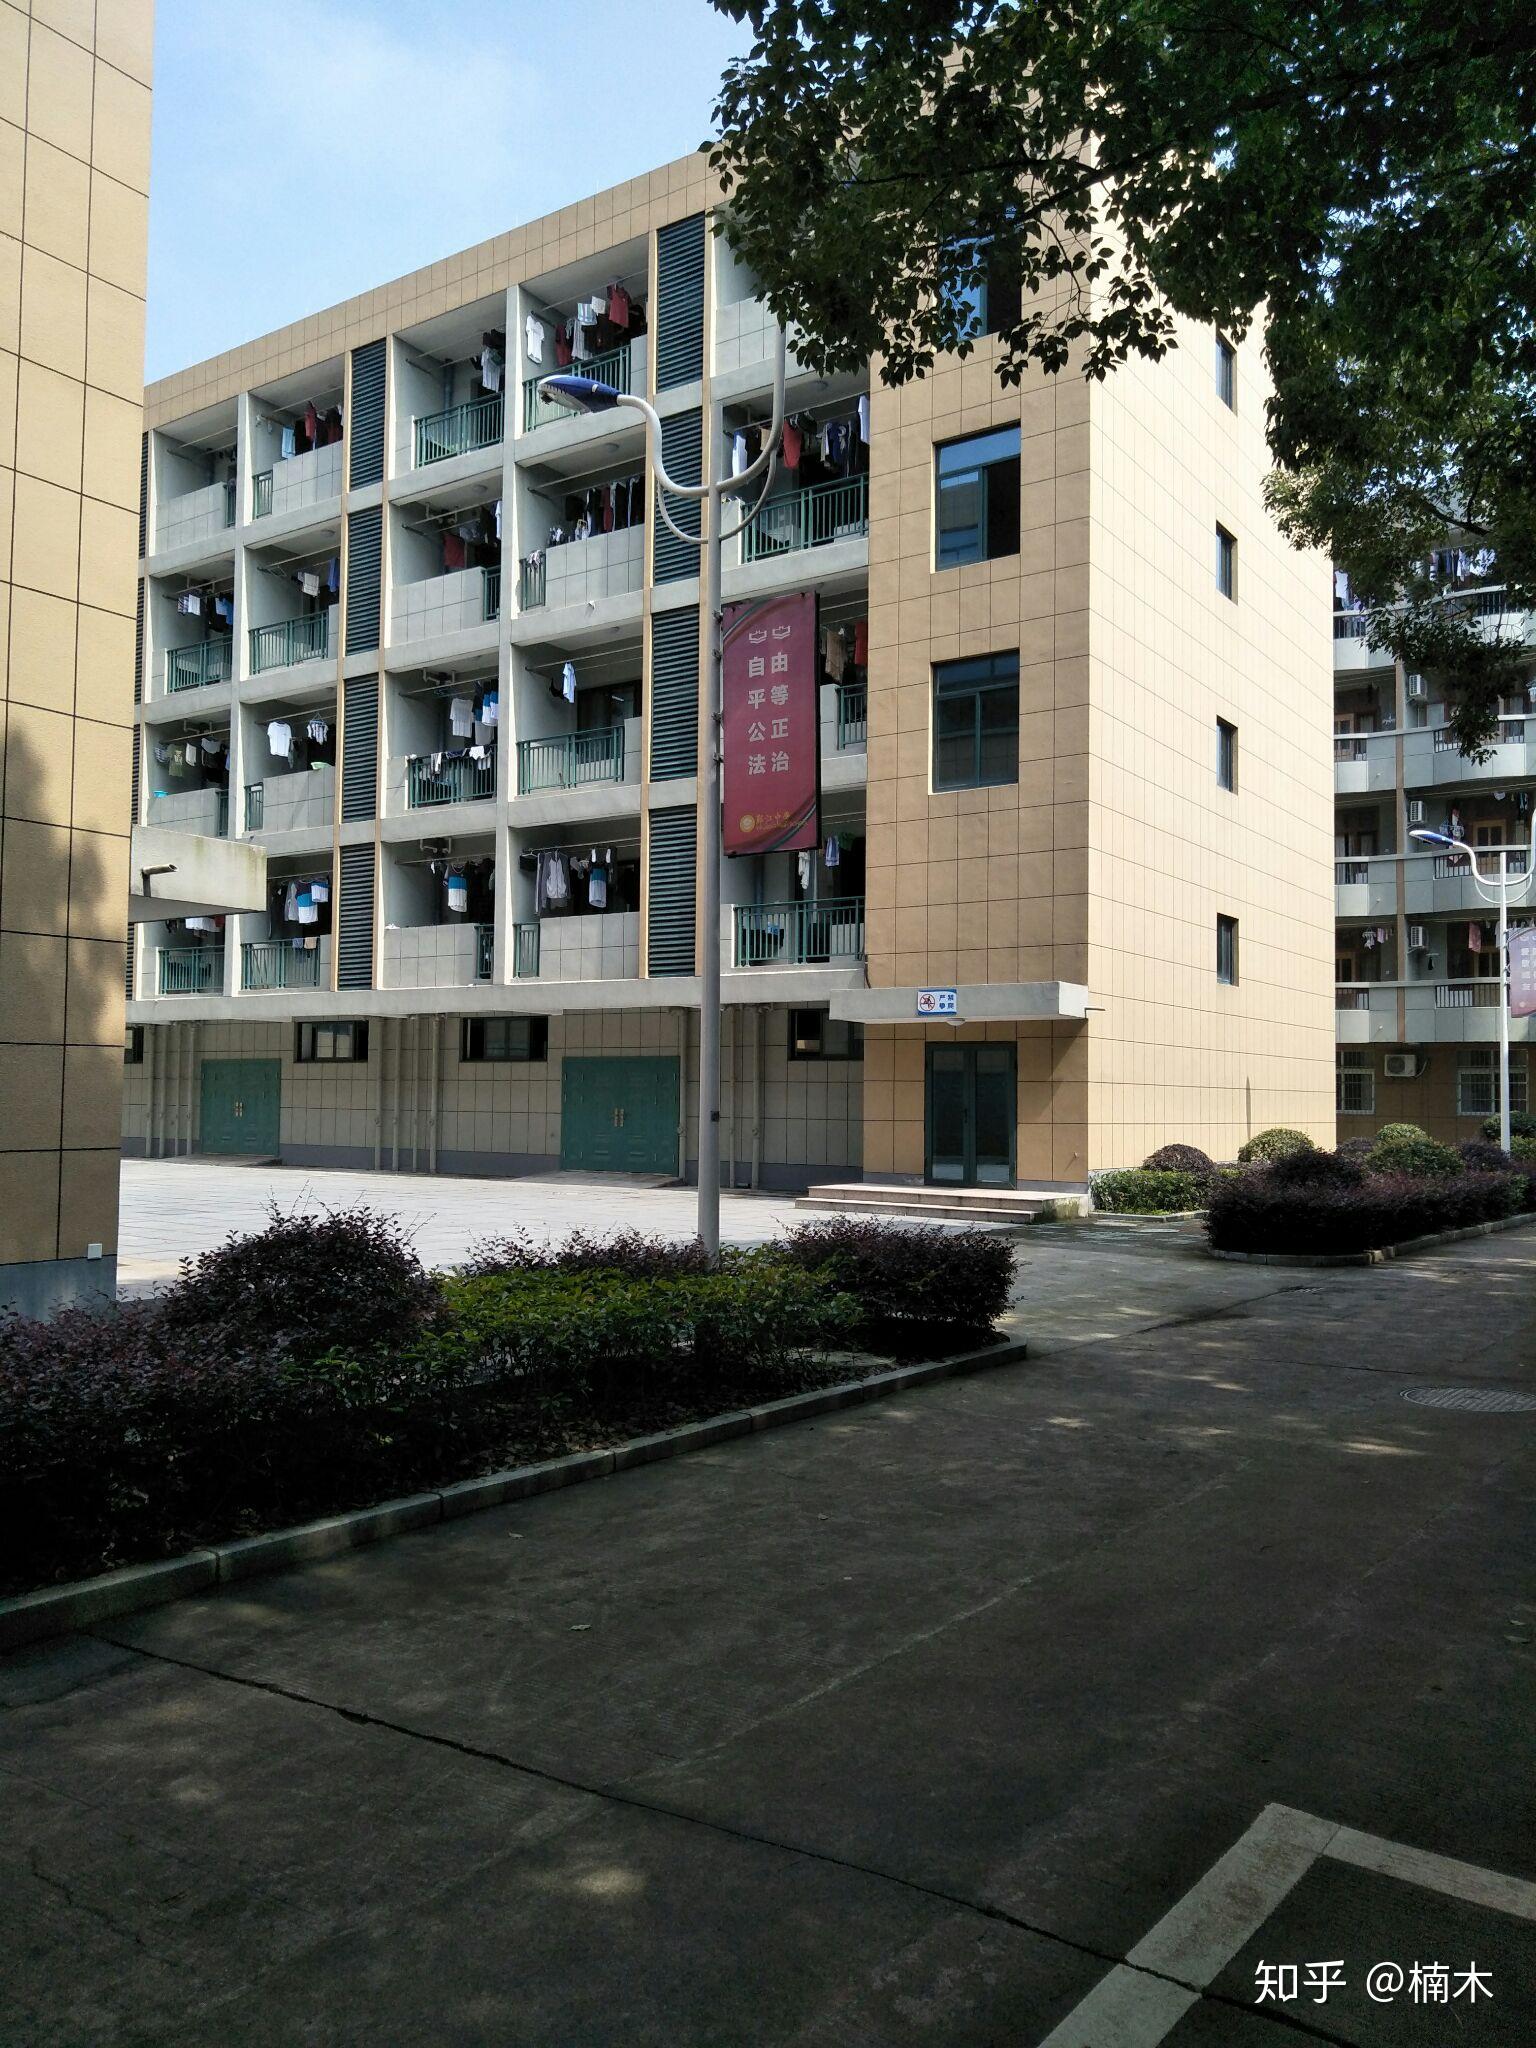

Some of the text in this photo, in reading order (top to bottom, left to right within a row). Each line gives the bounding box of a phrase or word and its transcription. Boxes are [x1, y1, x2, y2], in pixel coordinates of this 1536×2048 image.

[748, 652, 788, 678] 自由
[748, 685, 789, 709] 平等
[748, 718, 789, 742] 公正
[748, 751, 789, 775] 法治
